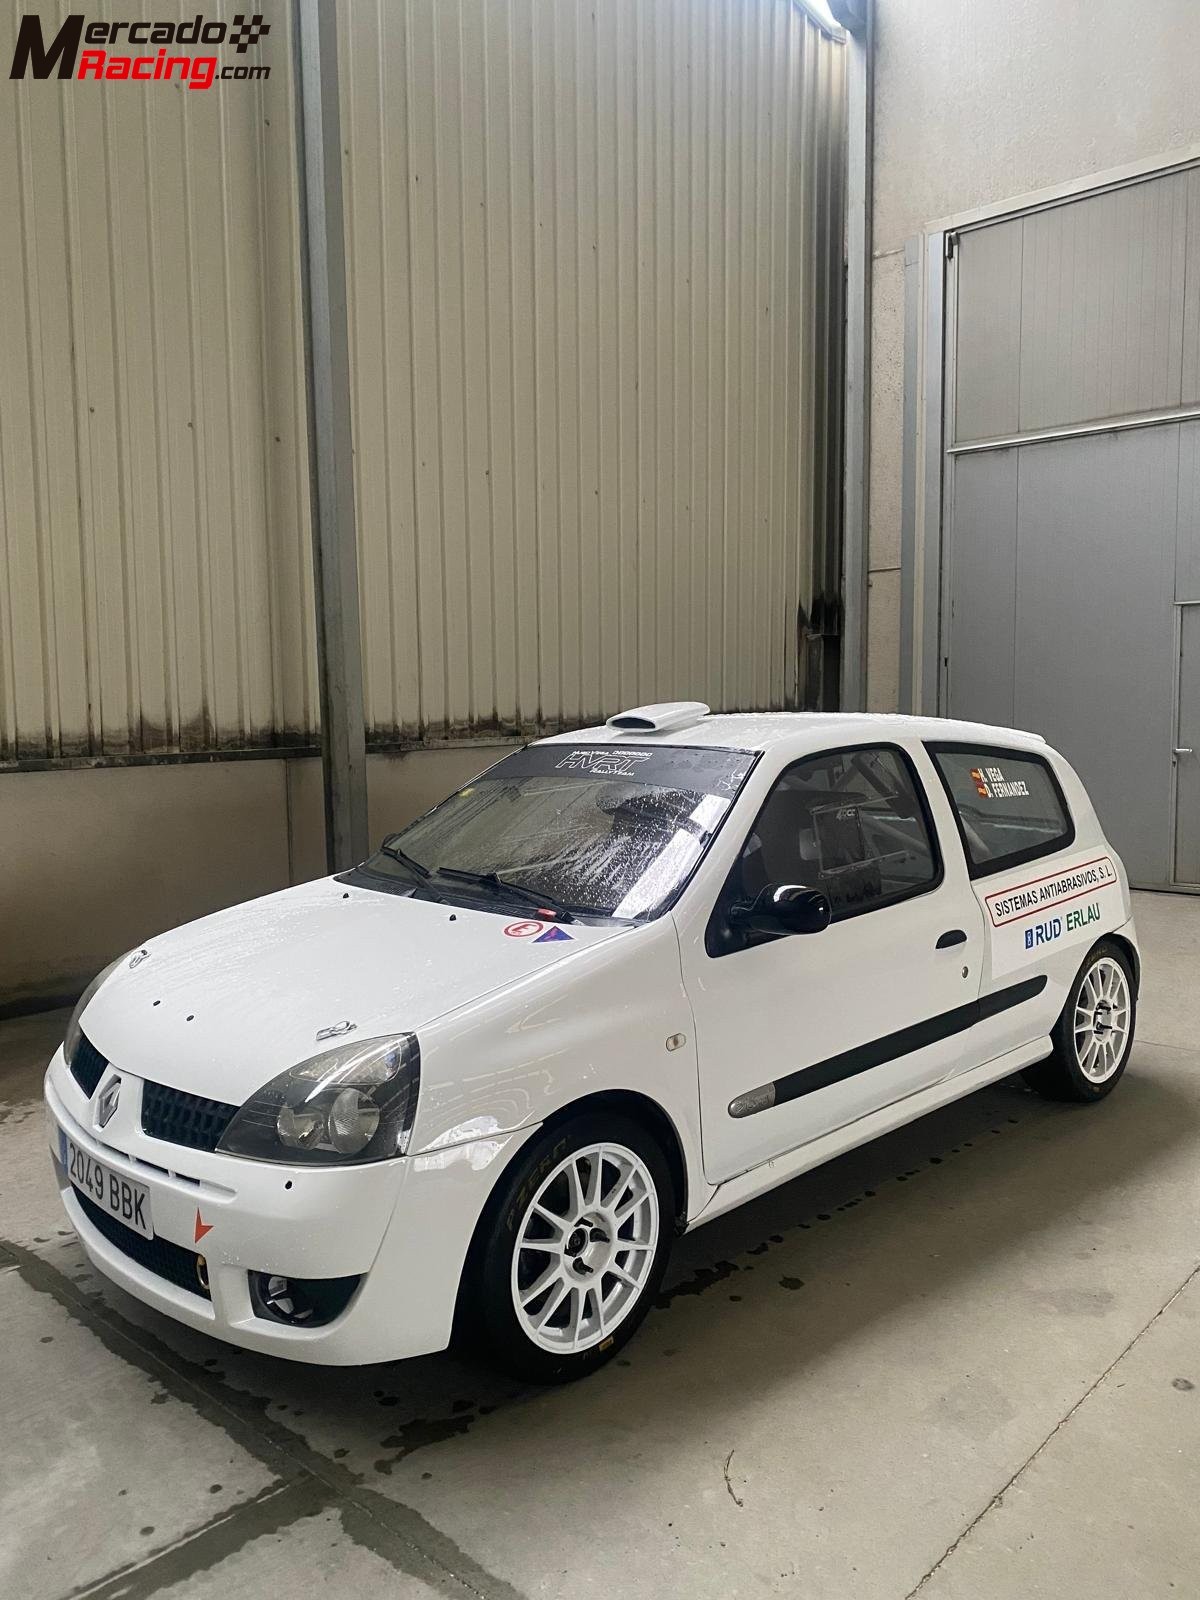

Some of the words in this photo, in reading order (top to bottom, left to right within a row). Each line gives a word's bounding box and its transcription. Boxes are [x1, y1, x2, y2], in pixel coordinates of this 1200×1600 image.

[991, 781, 1030, 798] FERNANDEZ
[994, 890, 1038, 917] SISTEMAS
[1039, 869, 1100, 902] ANTIABRASIVOS,
[1035, 917, 1062, 946] RUD
[1066, 902, 1101, 932] ERLAU
[69, 1142, 104, 1201] 2049
[109, 1173, 147, 1231] BBK
